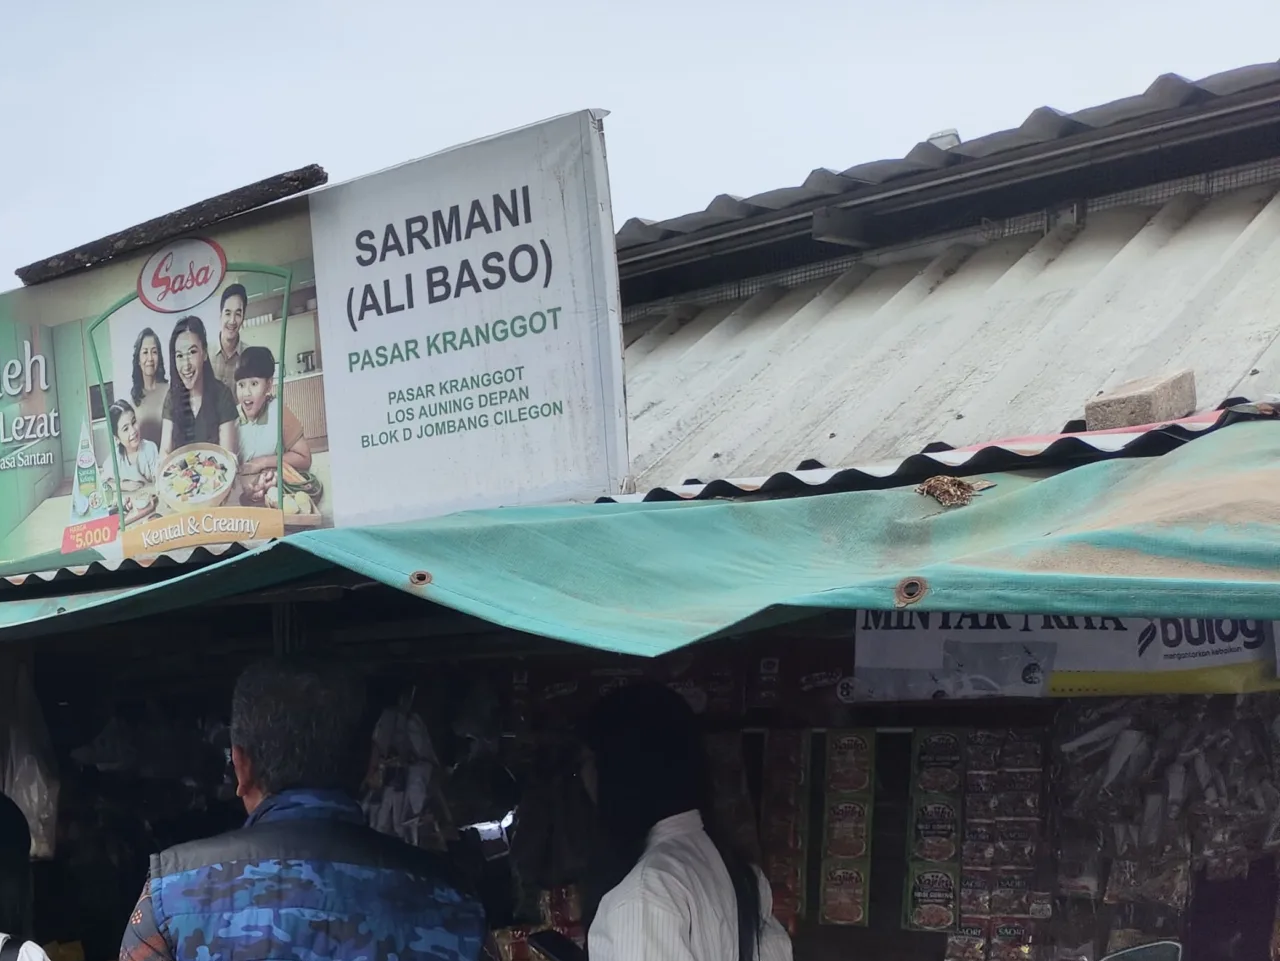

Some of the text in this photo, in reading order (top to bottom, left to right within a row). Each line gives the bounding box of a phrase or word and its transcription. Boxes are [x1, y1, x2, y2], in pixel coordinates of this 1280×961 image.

[355, 184, 532, 267] SARMANI
[150, 251, 215, 302] Sasa
[346, 238, 553, 332] (ALI BASO)
[348, 306, 562, 373] PASAR KRANGGOT
[387, 385, 530, 425] LOS AUNING DEPAN
[388, 365, 525, 405] PASAR KRANGGOT
[361, 400, 564, 449] BLOK D JOMBANG CILEGON
[17, 451, 54, 468] Santan
[141, 513, 260, 549] Kental & Creamy
